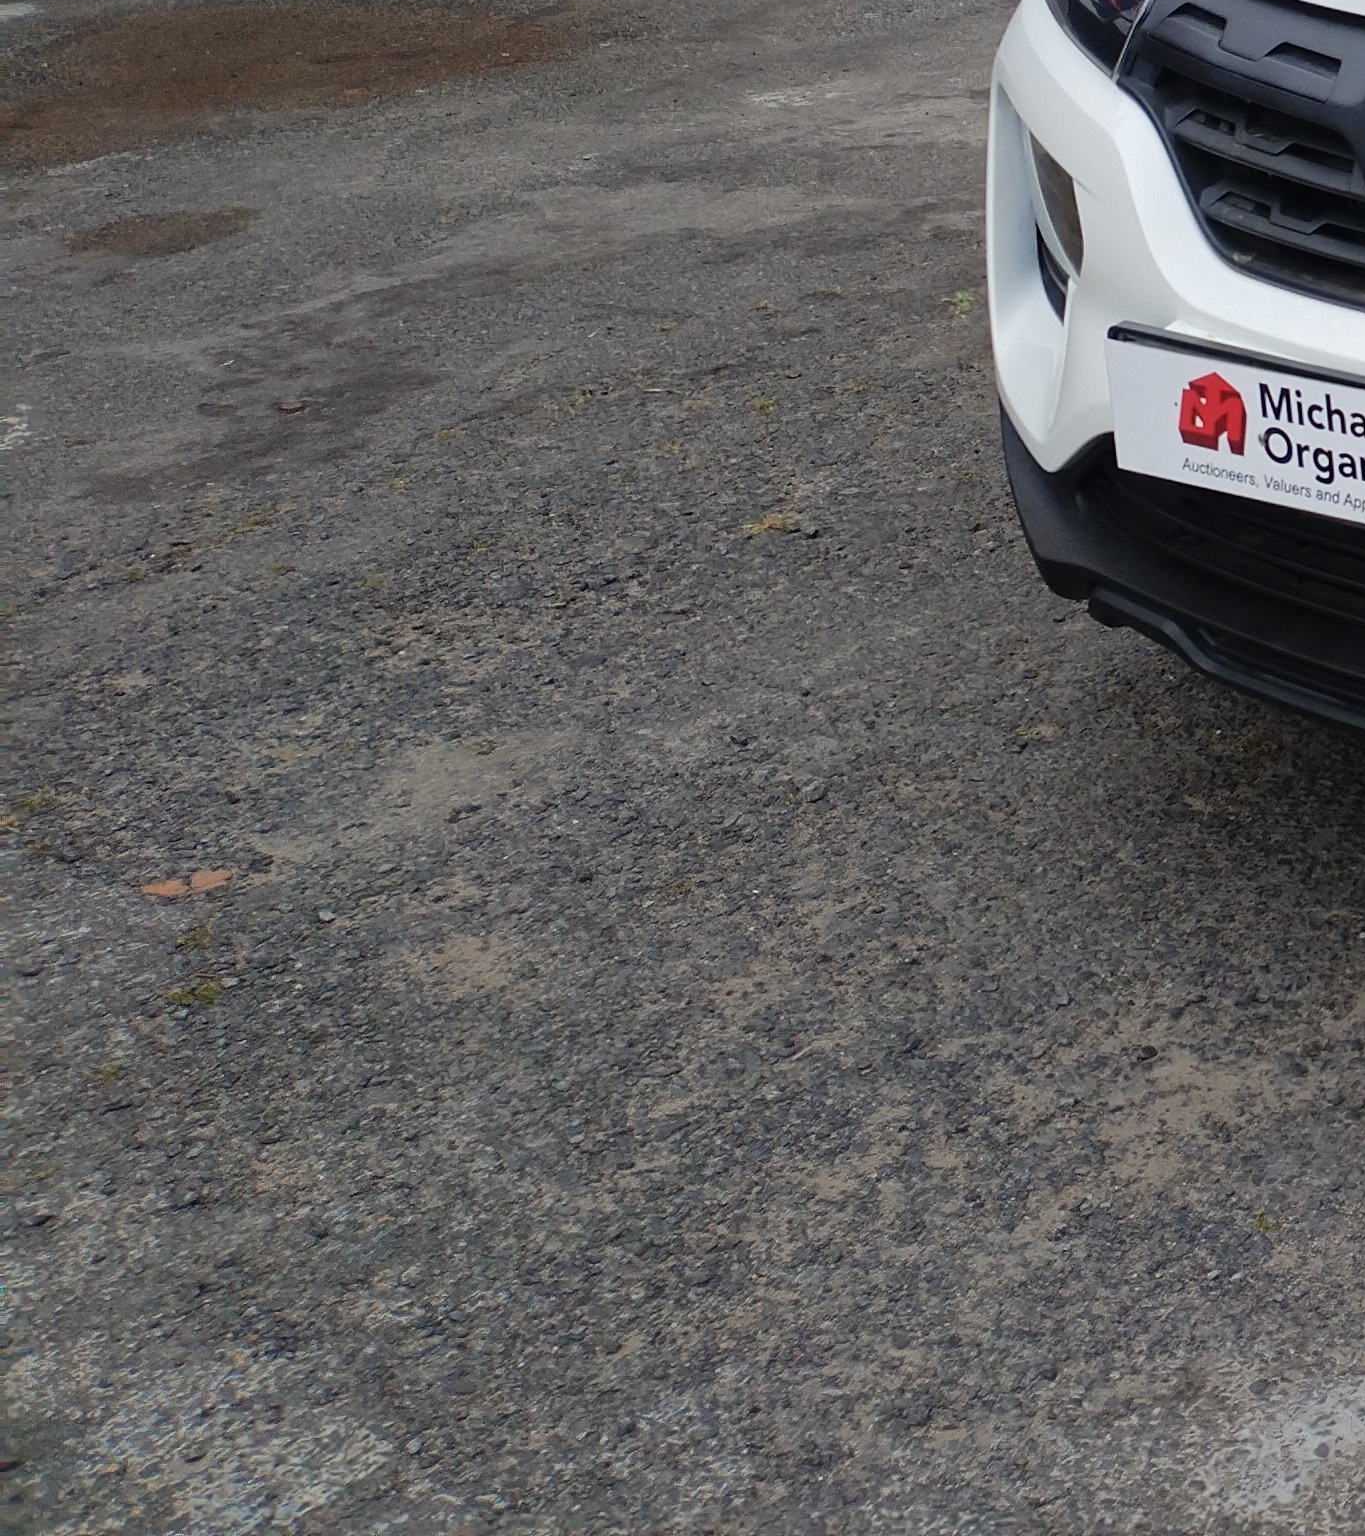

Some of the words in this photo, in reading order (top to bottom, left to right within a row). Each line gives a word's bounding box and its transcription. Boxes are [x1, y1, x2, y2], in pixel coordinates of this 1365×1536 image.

[1182, 457, 1260, 488] Auctioneers,
[1264, 474, 1312, 499] Valuers
[1316, 488, 1340, 504] and
